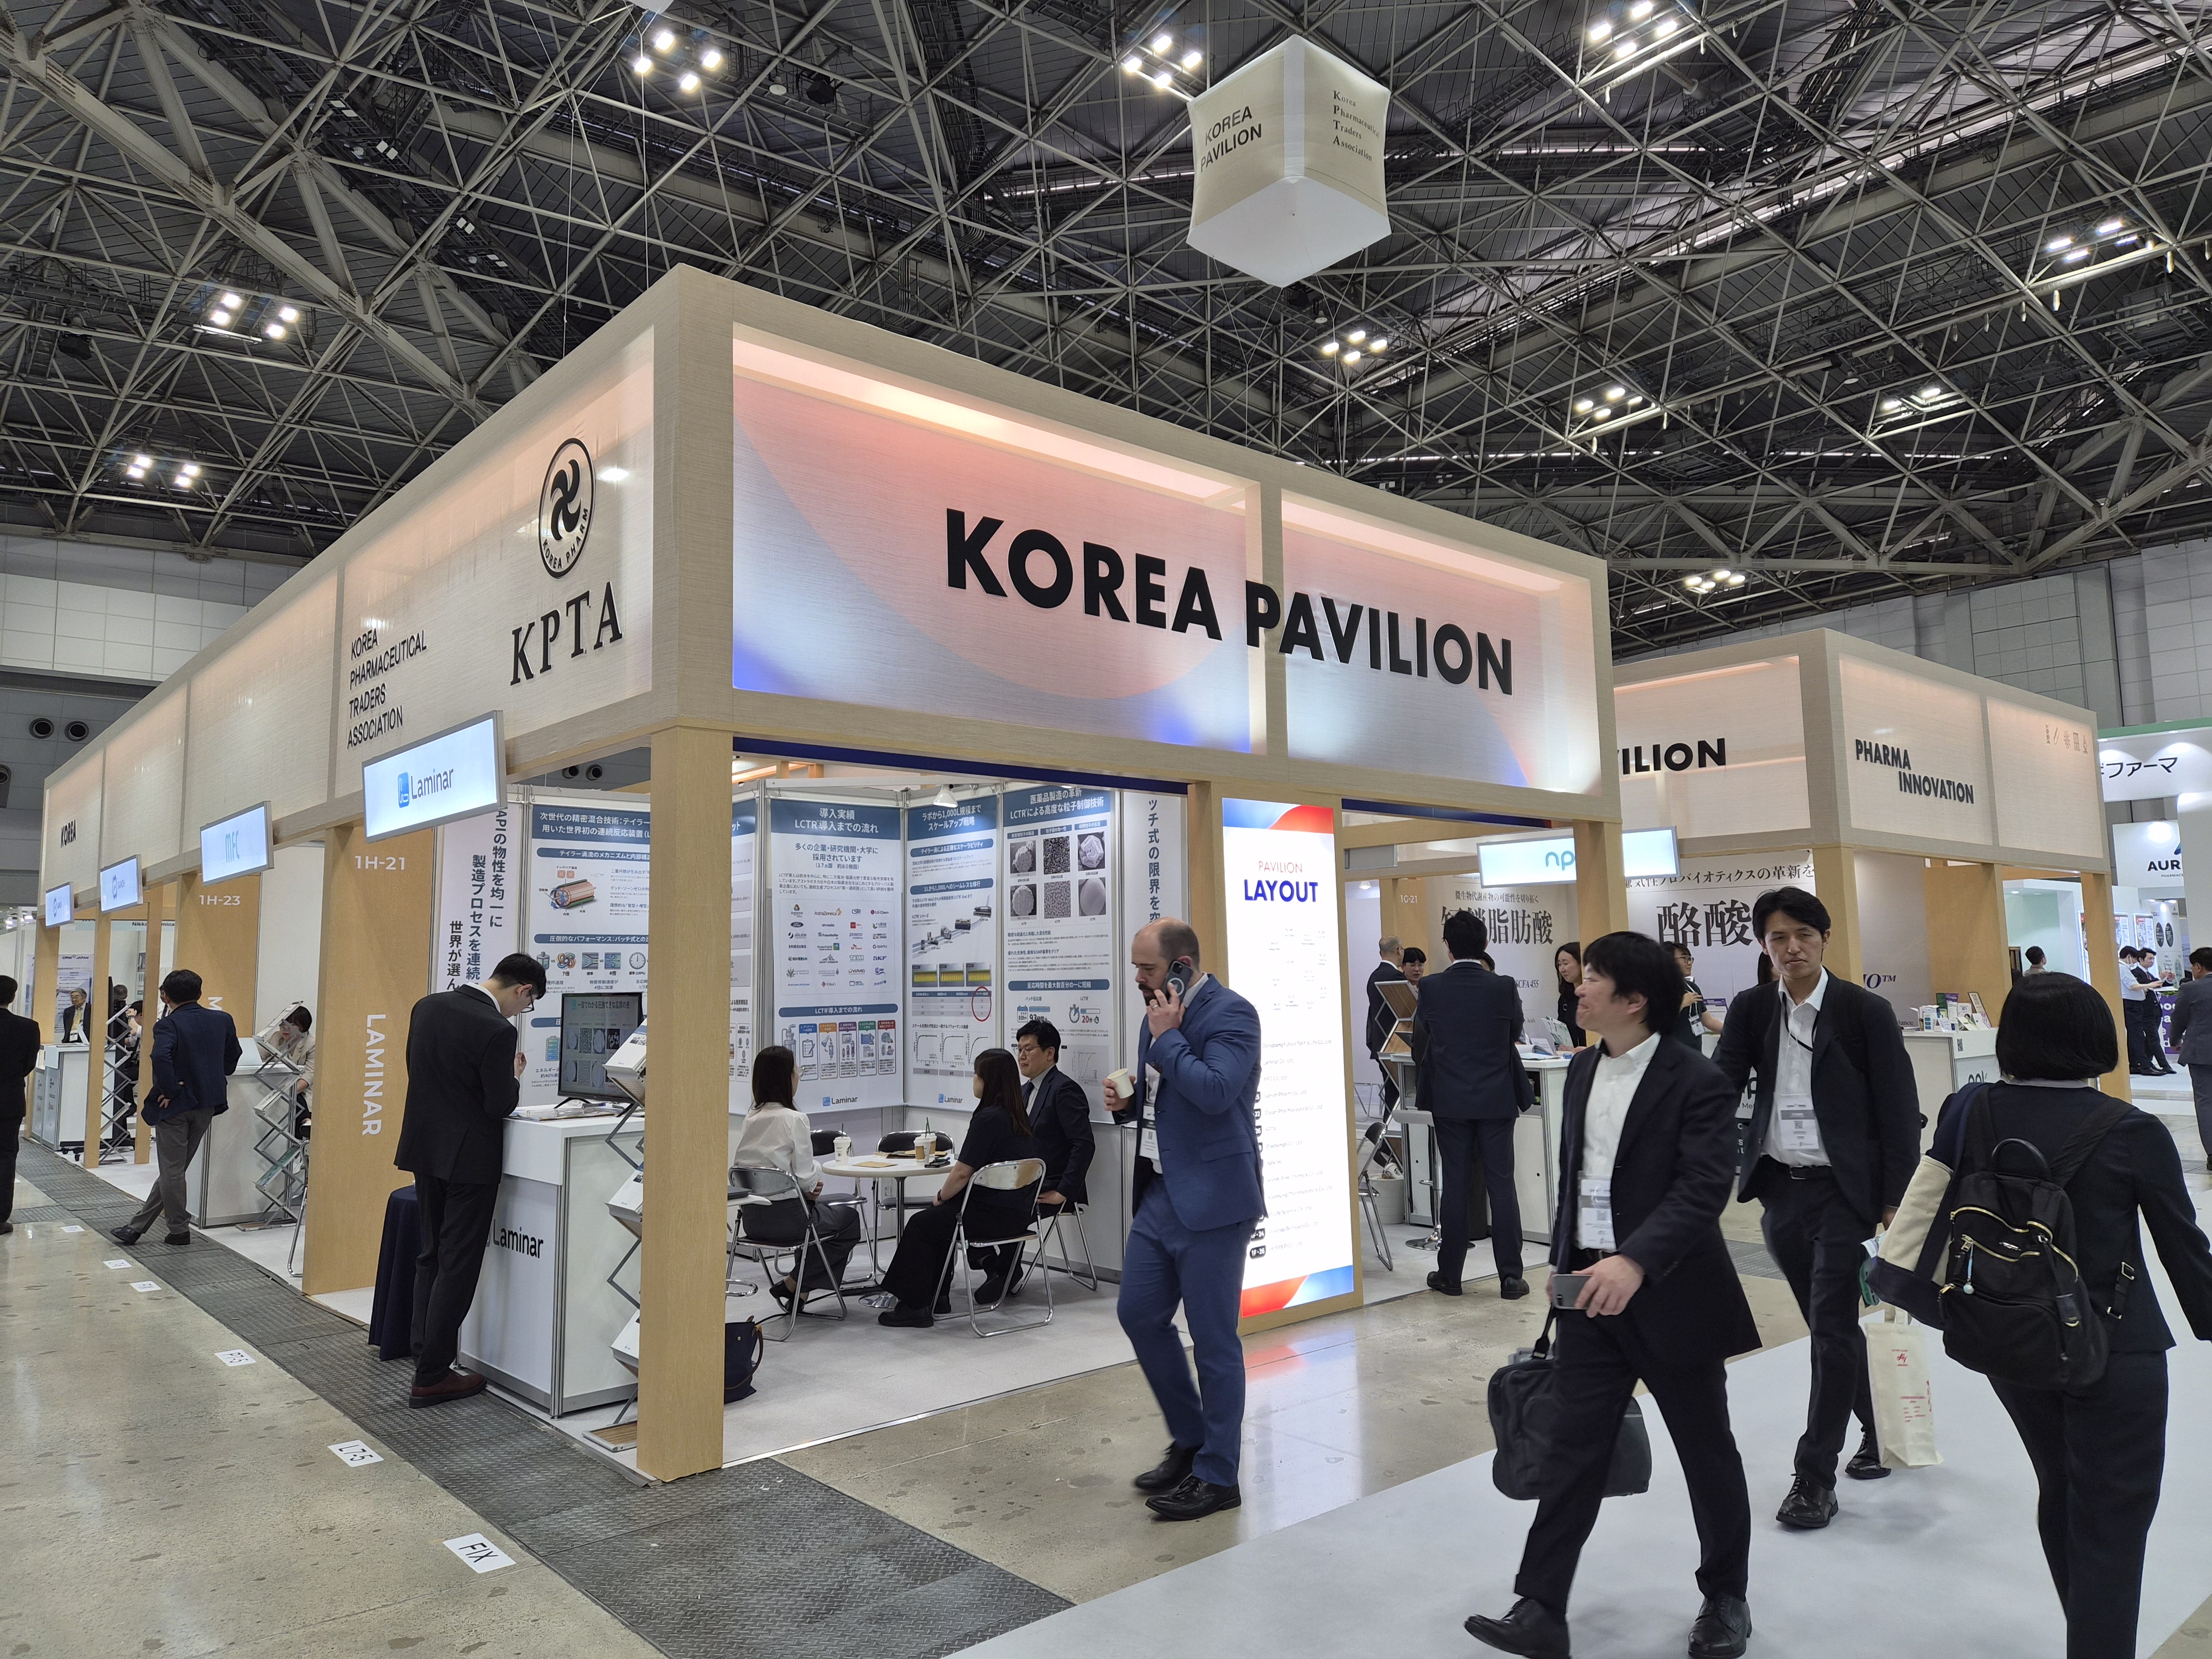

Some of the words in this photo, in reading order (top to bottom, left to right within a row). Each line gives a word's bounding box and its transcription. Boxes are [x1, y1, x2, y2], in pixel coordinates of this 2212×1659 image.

[1333, 90, 1357, 107] Korea
[1205, 106, 1253, 145] KOREA
[1333, 105, 1380, 139] Pharmaceutical
[1333, 119, 1363, 139] Traders
[1201, 123, 1262, 172] PAVILION
[1333, 135, 1373, 161] Association
[542, 539, 562, 570] KOREA
[566, 507, 589, 564] PHARM
[946, 507, 1223, 641] KOREA
[1245, 580, 1513, 696] PAVILION
[351, 628, 379, 661] KOREA
[510, 581, 623, 686] KPTA
[350, 630, 427, 690] PHARMACEUTICAL
[349, 683, 387, 719] TRADERS
[347, 706, 403, 749] ASSOCIATION
[1617, 737, 1726, 775] ILION
[1856, 738, 1912, 770] PHARMA
[2101, 757, 2178, 779] ファーマ
[410, 766, 454, 800] Laminar
[1898, 771, 1974, 804] INNOVATION
[60, 819, 77, 848] KOREA
[355, 855, 406, 870] 1H-21
[1259, 861, 1302, 873] PAVILION
[2147, 859, 2182, 872] AUR
[199, 895, 241, 906] 1H-23
[1244, 879, 1318, 902] LAYOUT
[1400, 895, 1418, 904] 1G-21
[466, 855, 486, 984] 製造プロセスを連続
[1441, 905, 1553, 945] 脂肪酸
[1656, 899, 1754, 947] 酪酸
[446, 920, 463, 990] 世界が選ん
[362, 1014, 386, 1136] LAMINAR
[945, 1095, 963, 1104] Laminar
[493, 1218, 544, 1259] Laminar
[221, 1350, 249, 1365] P7-5
[338, 1443, 371, 1463] L7-5
[458, 1541, 498, 1564] FIX
